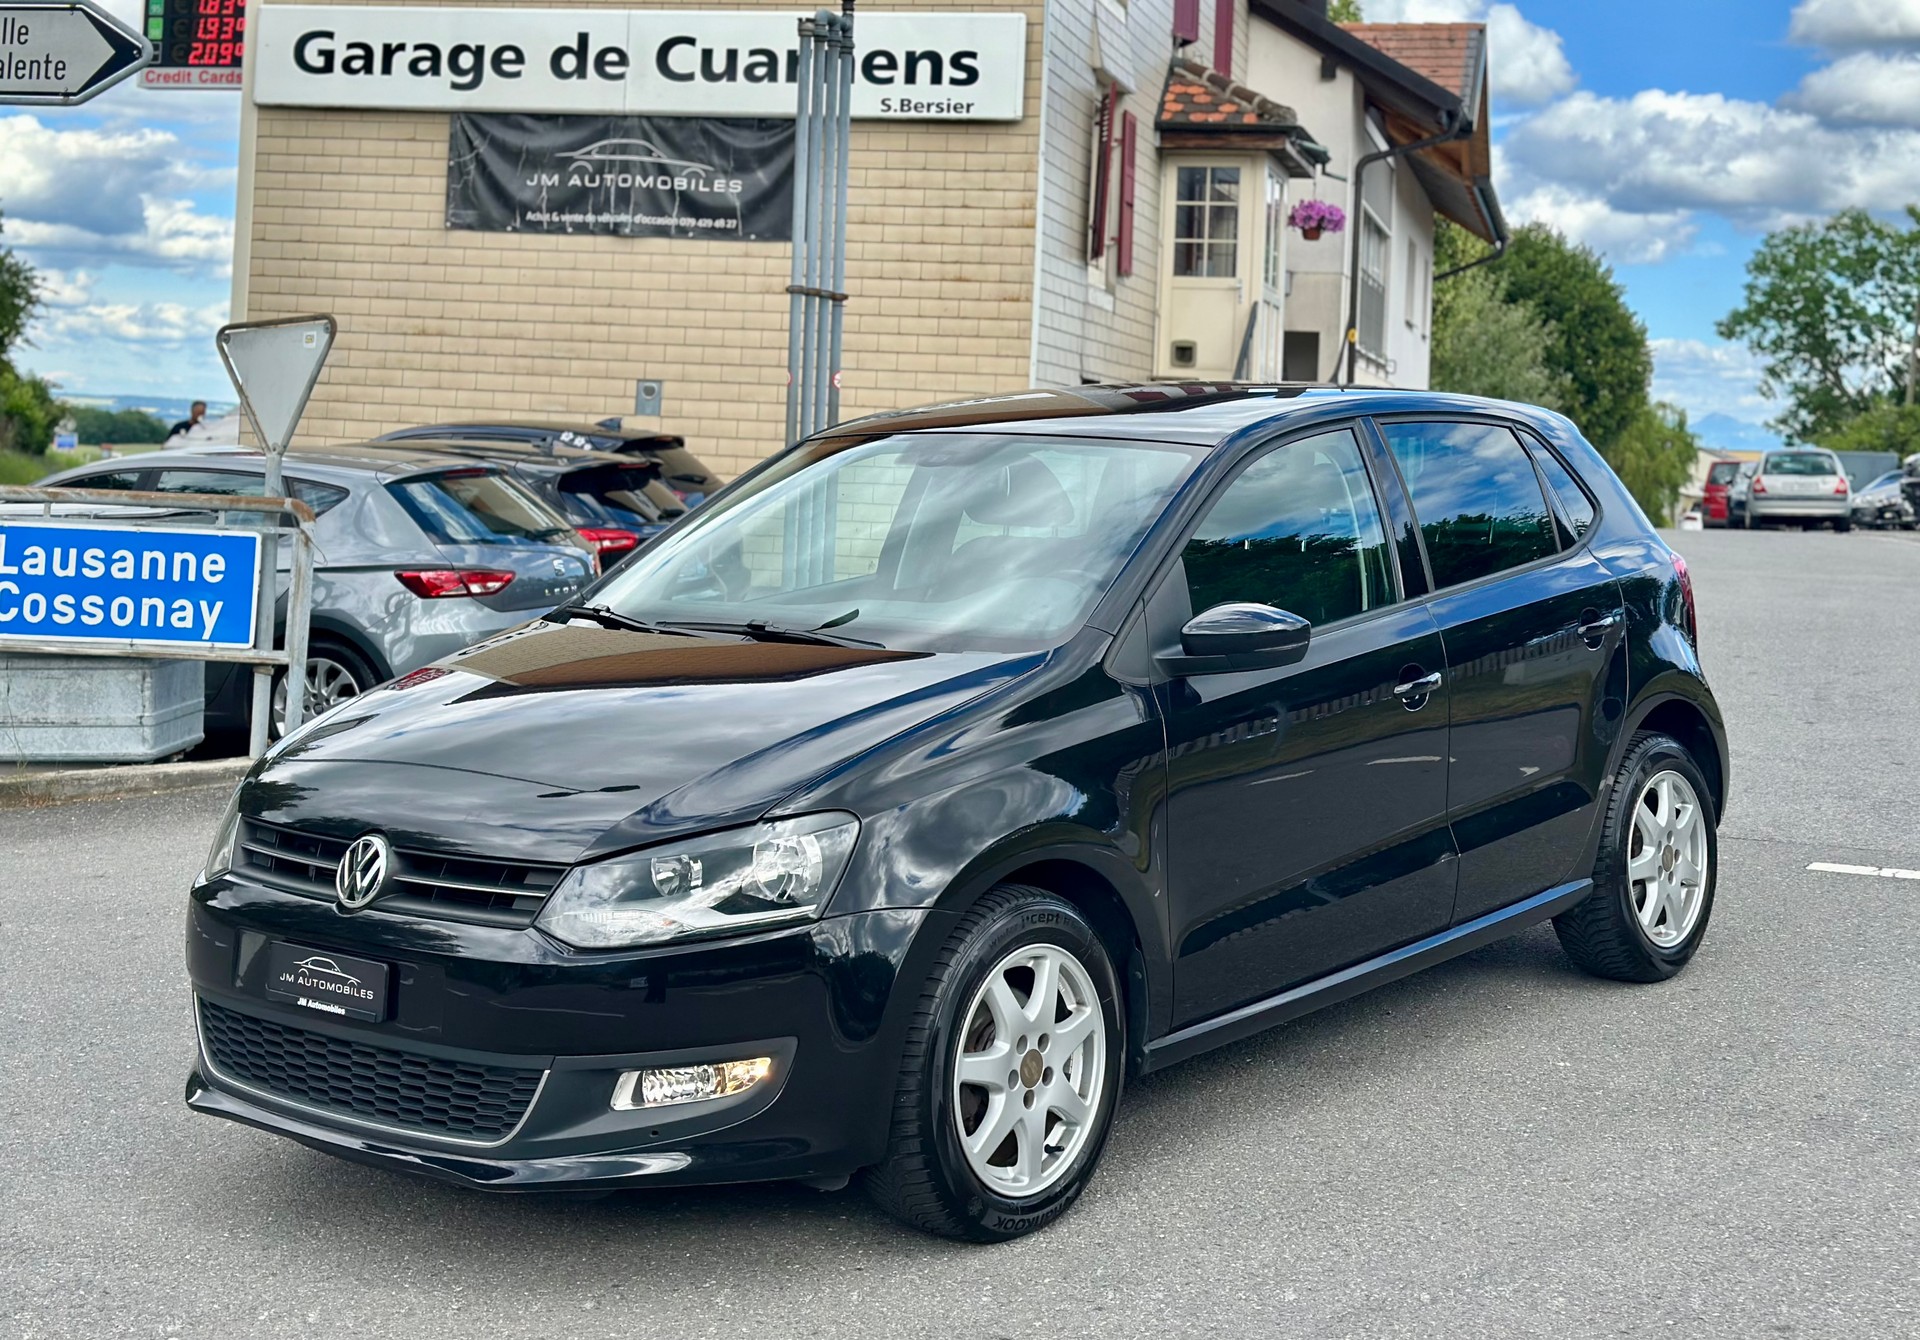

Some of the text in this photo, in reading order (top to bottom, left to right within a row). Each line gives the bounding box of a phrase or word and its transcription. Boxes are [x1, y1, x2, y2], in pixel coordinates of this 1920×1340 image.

[292, 29, 526, 92] Garage
[549, 31, 630, 81] de
[145, 69, 243, 84] Credit Cards
[879, 97, 976, 115] S.Bersier
[526, 172, 743, 194] JM AUTOMOBILES
[0, 534, 226, 584] Lausanne
[0, 580, 224, 640] Cossonay
[279, 972, 374, 1000] JM AUTOMOBILES
[307, 1000, 346, 1016] Automobiles
